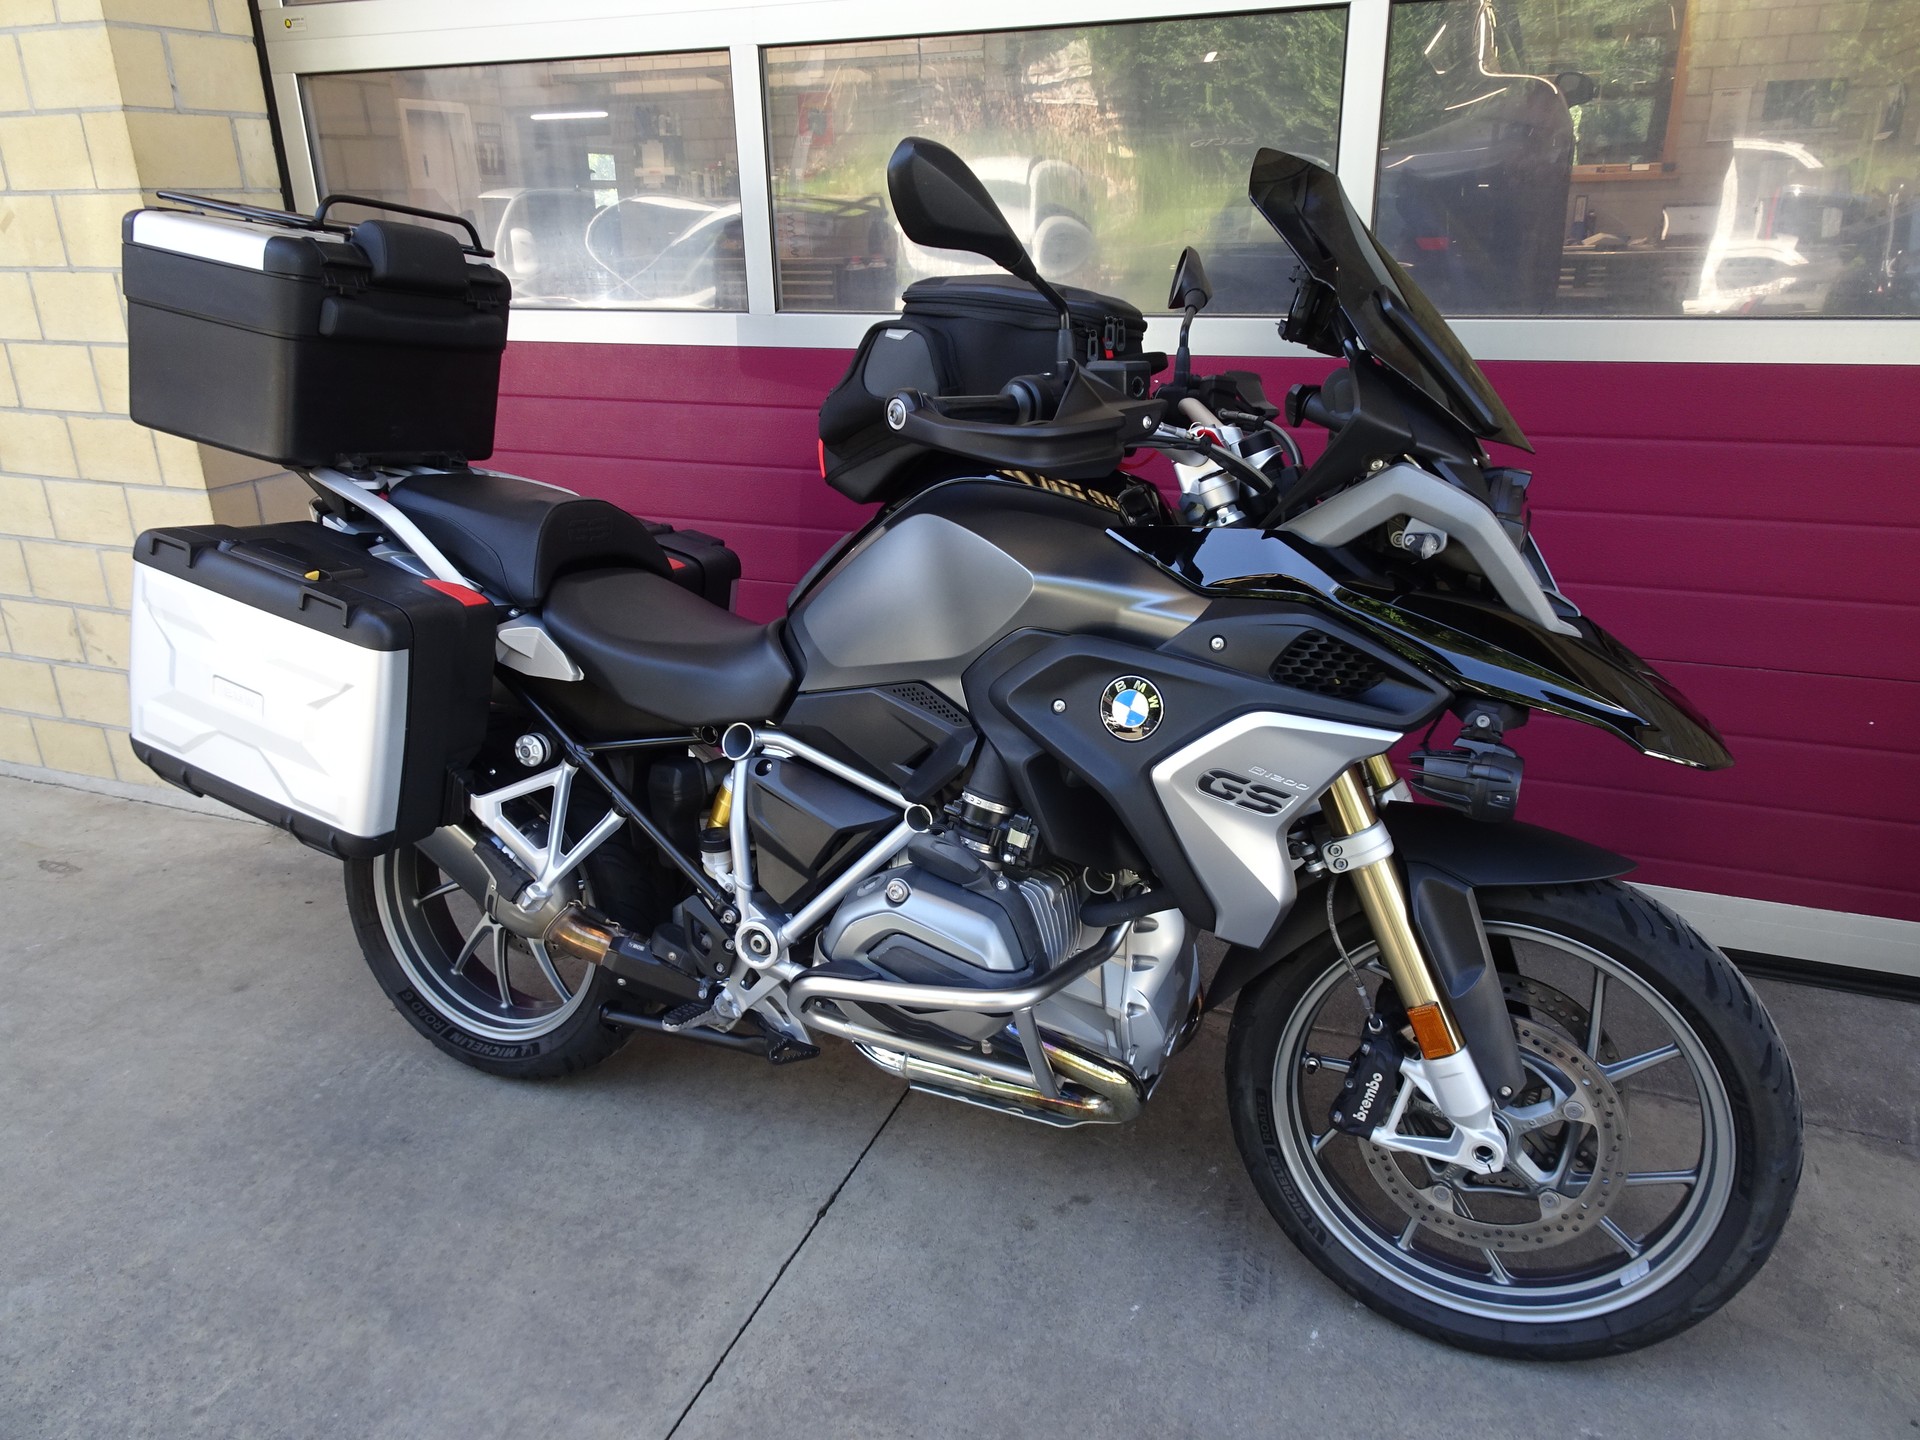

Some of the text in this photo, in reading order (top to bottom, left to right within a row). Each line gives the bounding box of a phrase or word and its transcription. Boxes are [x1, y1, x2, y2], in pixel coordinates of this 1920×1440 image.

[1114, 680, 1160, 708] BMW
[1197, 769, 1292, 814] GS
[401, 990, 442, 1031] ROAD 6
[449, 1031, 519, 1058] MICHELIN
[1352, 1072, 1383, 1122] brembo
[1258, 1107, 1272, 1141] ROAD
[1269, 1155, 1309, 1223] MICHELIN
